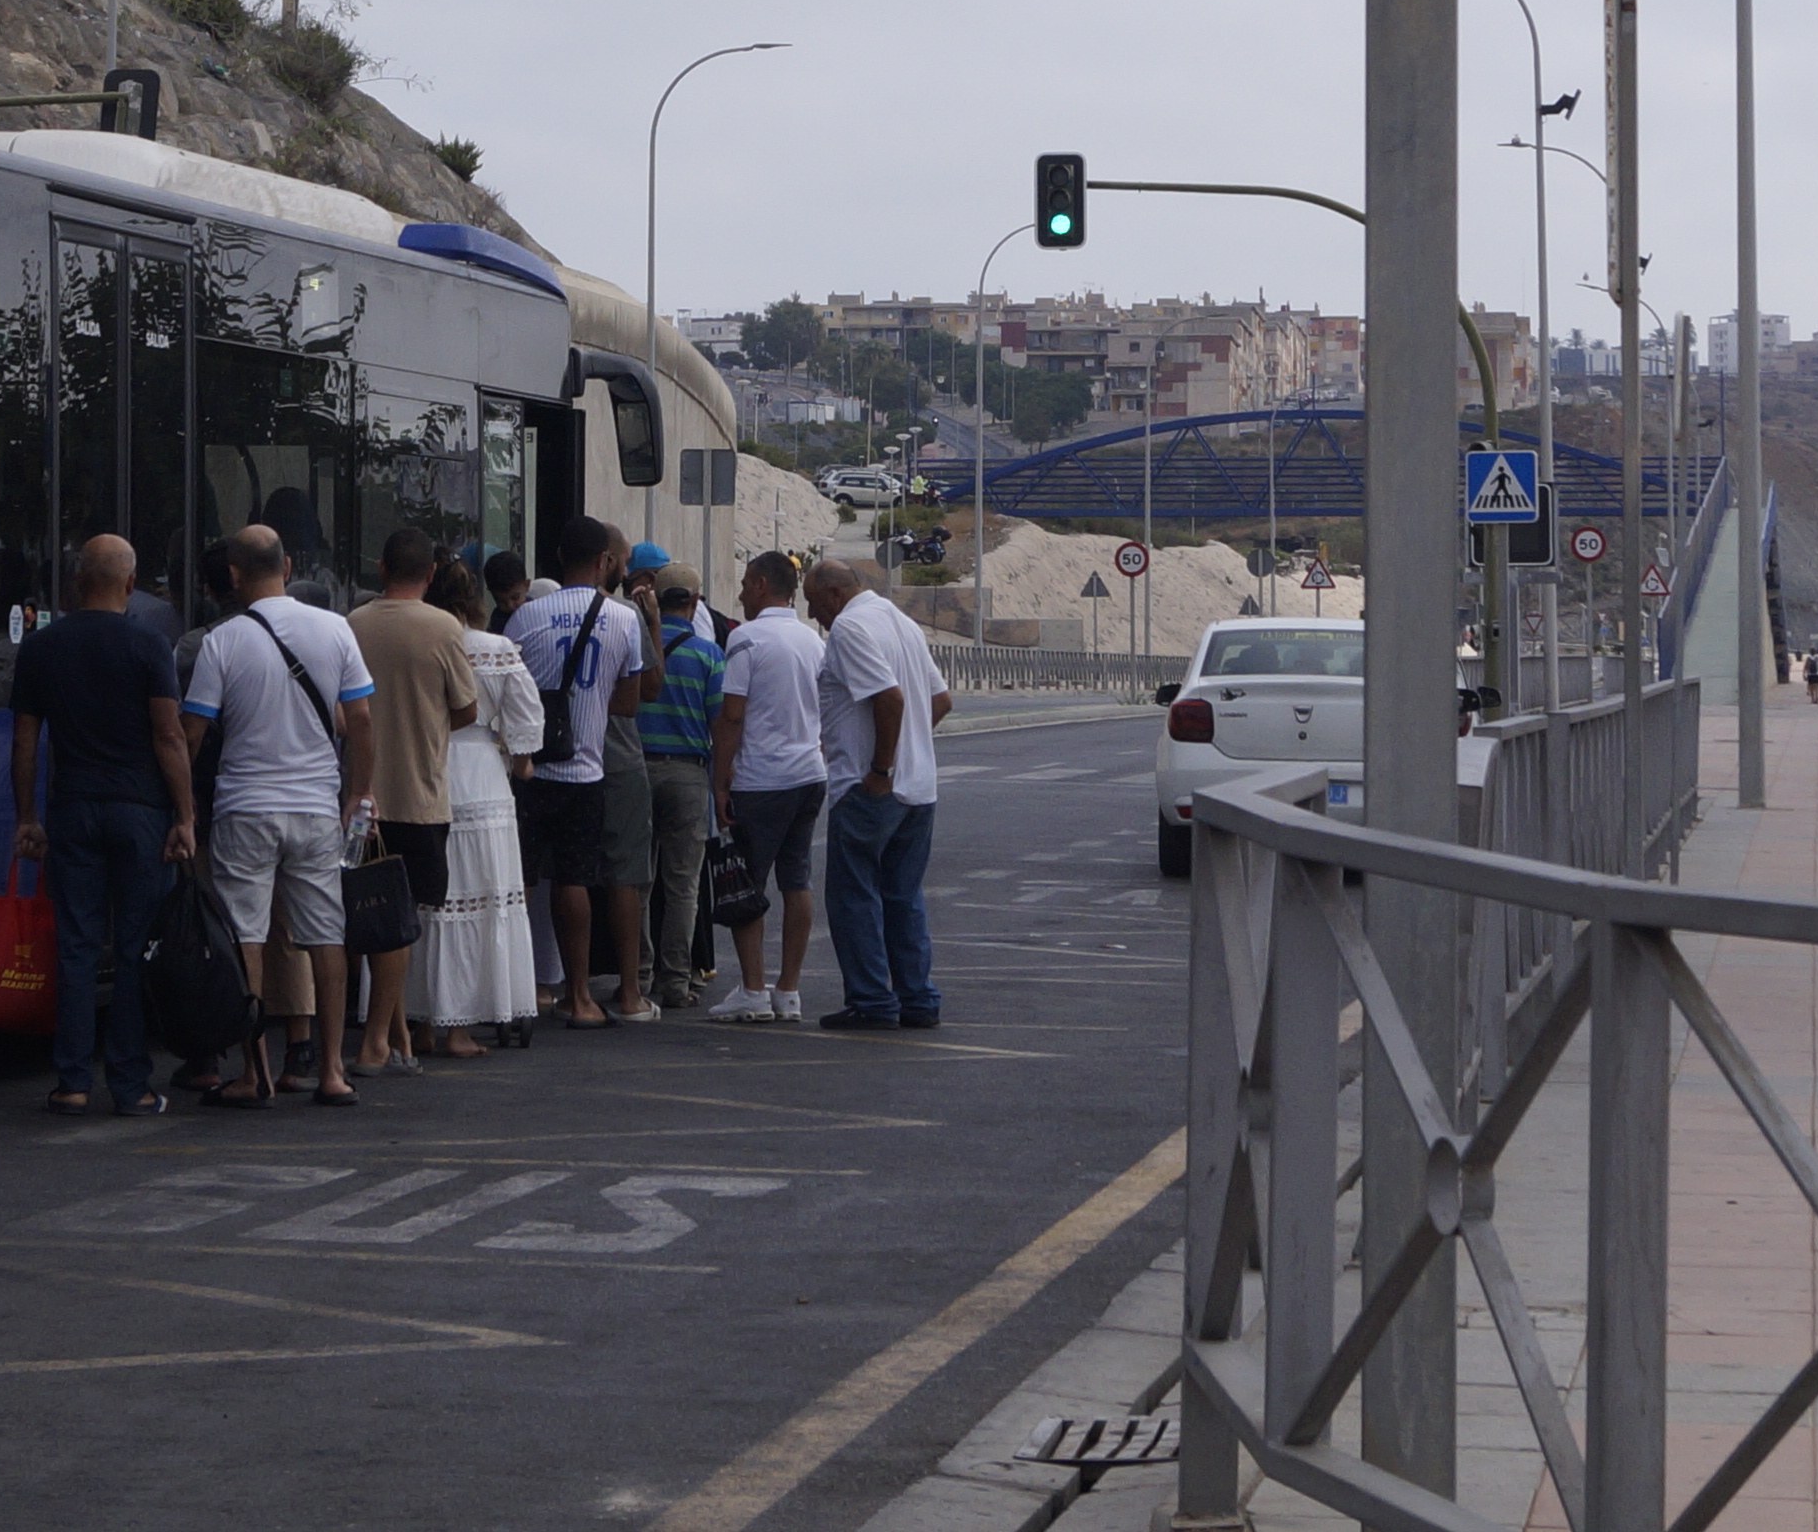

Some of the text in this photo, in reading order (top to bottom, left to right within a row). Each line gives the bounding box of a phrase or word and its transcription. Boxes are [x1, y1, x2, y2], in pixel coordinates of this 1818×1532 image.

[1579, 538, 1599, 551] 50
[1122, 553, 1142, 566] 50
[556, 635, 601, 689] 10
[0, 979, 46, 992] MARKET
[6, 1163, 790, 1254] BUS
